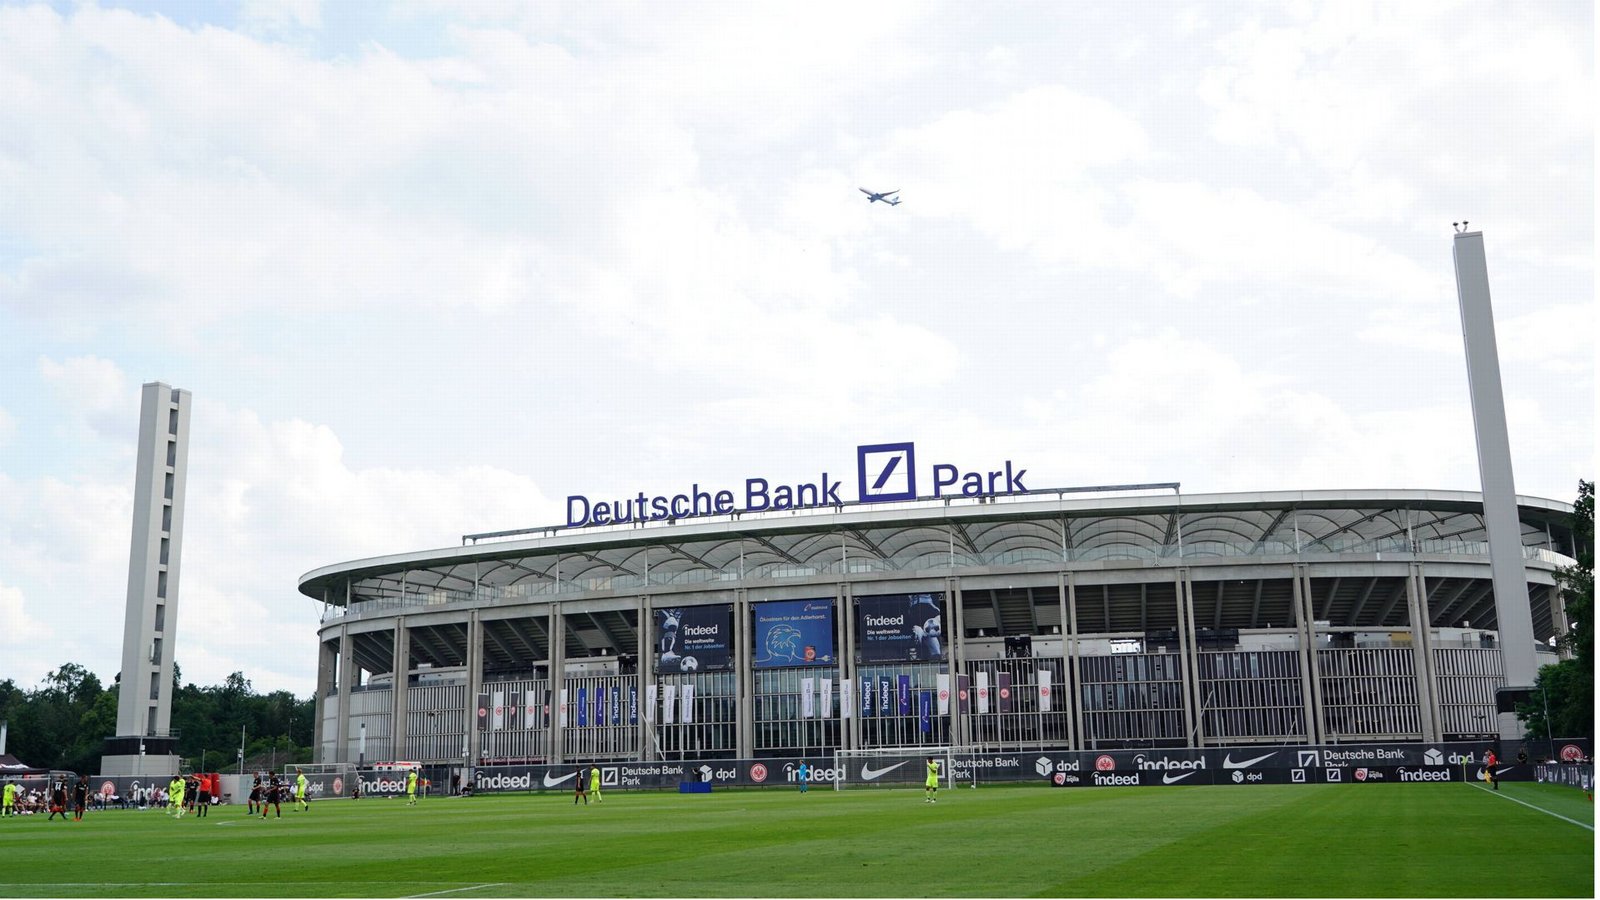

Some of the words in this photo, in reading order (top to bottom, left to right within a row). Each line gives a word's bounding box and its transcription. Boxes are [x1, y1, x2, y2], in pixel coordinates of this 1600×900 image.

[567, 484, 735, 528] Deutsche
[746, 473, 844, 512] Bank
[933, 460, 1030, 499] Park
[864, 614, 904, 626] indeed
[683, 624, 718, 636] indeed
[1324, 749, 1374, 760] Deutsche
[1376, 748, 1405, 759] Bank
[950, 758, 993, 769] Deutsche
[995, 756, 1019, 767] Bank
[621, 766, 660, 776] Deutsche
[662, 765, 683, 775] Bank
[716, 768, 736, 781] dpd
[950, 769, 971, 779] Park
[1247, 772, 1262, 781] dpd
[1396, 767, 1450, 782] indeed
[358, 776, 407, 793] indeed
[475, 771, 530, 789] indeed
[621, 777, 640, 786] Park
[1091, 771, 1139, 786] indeed
